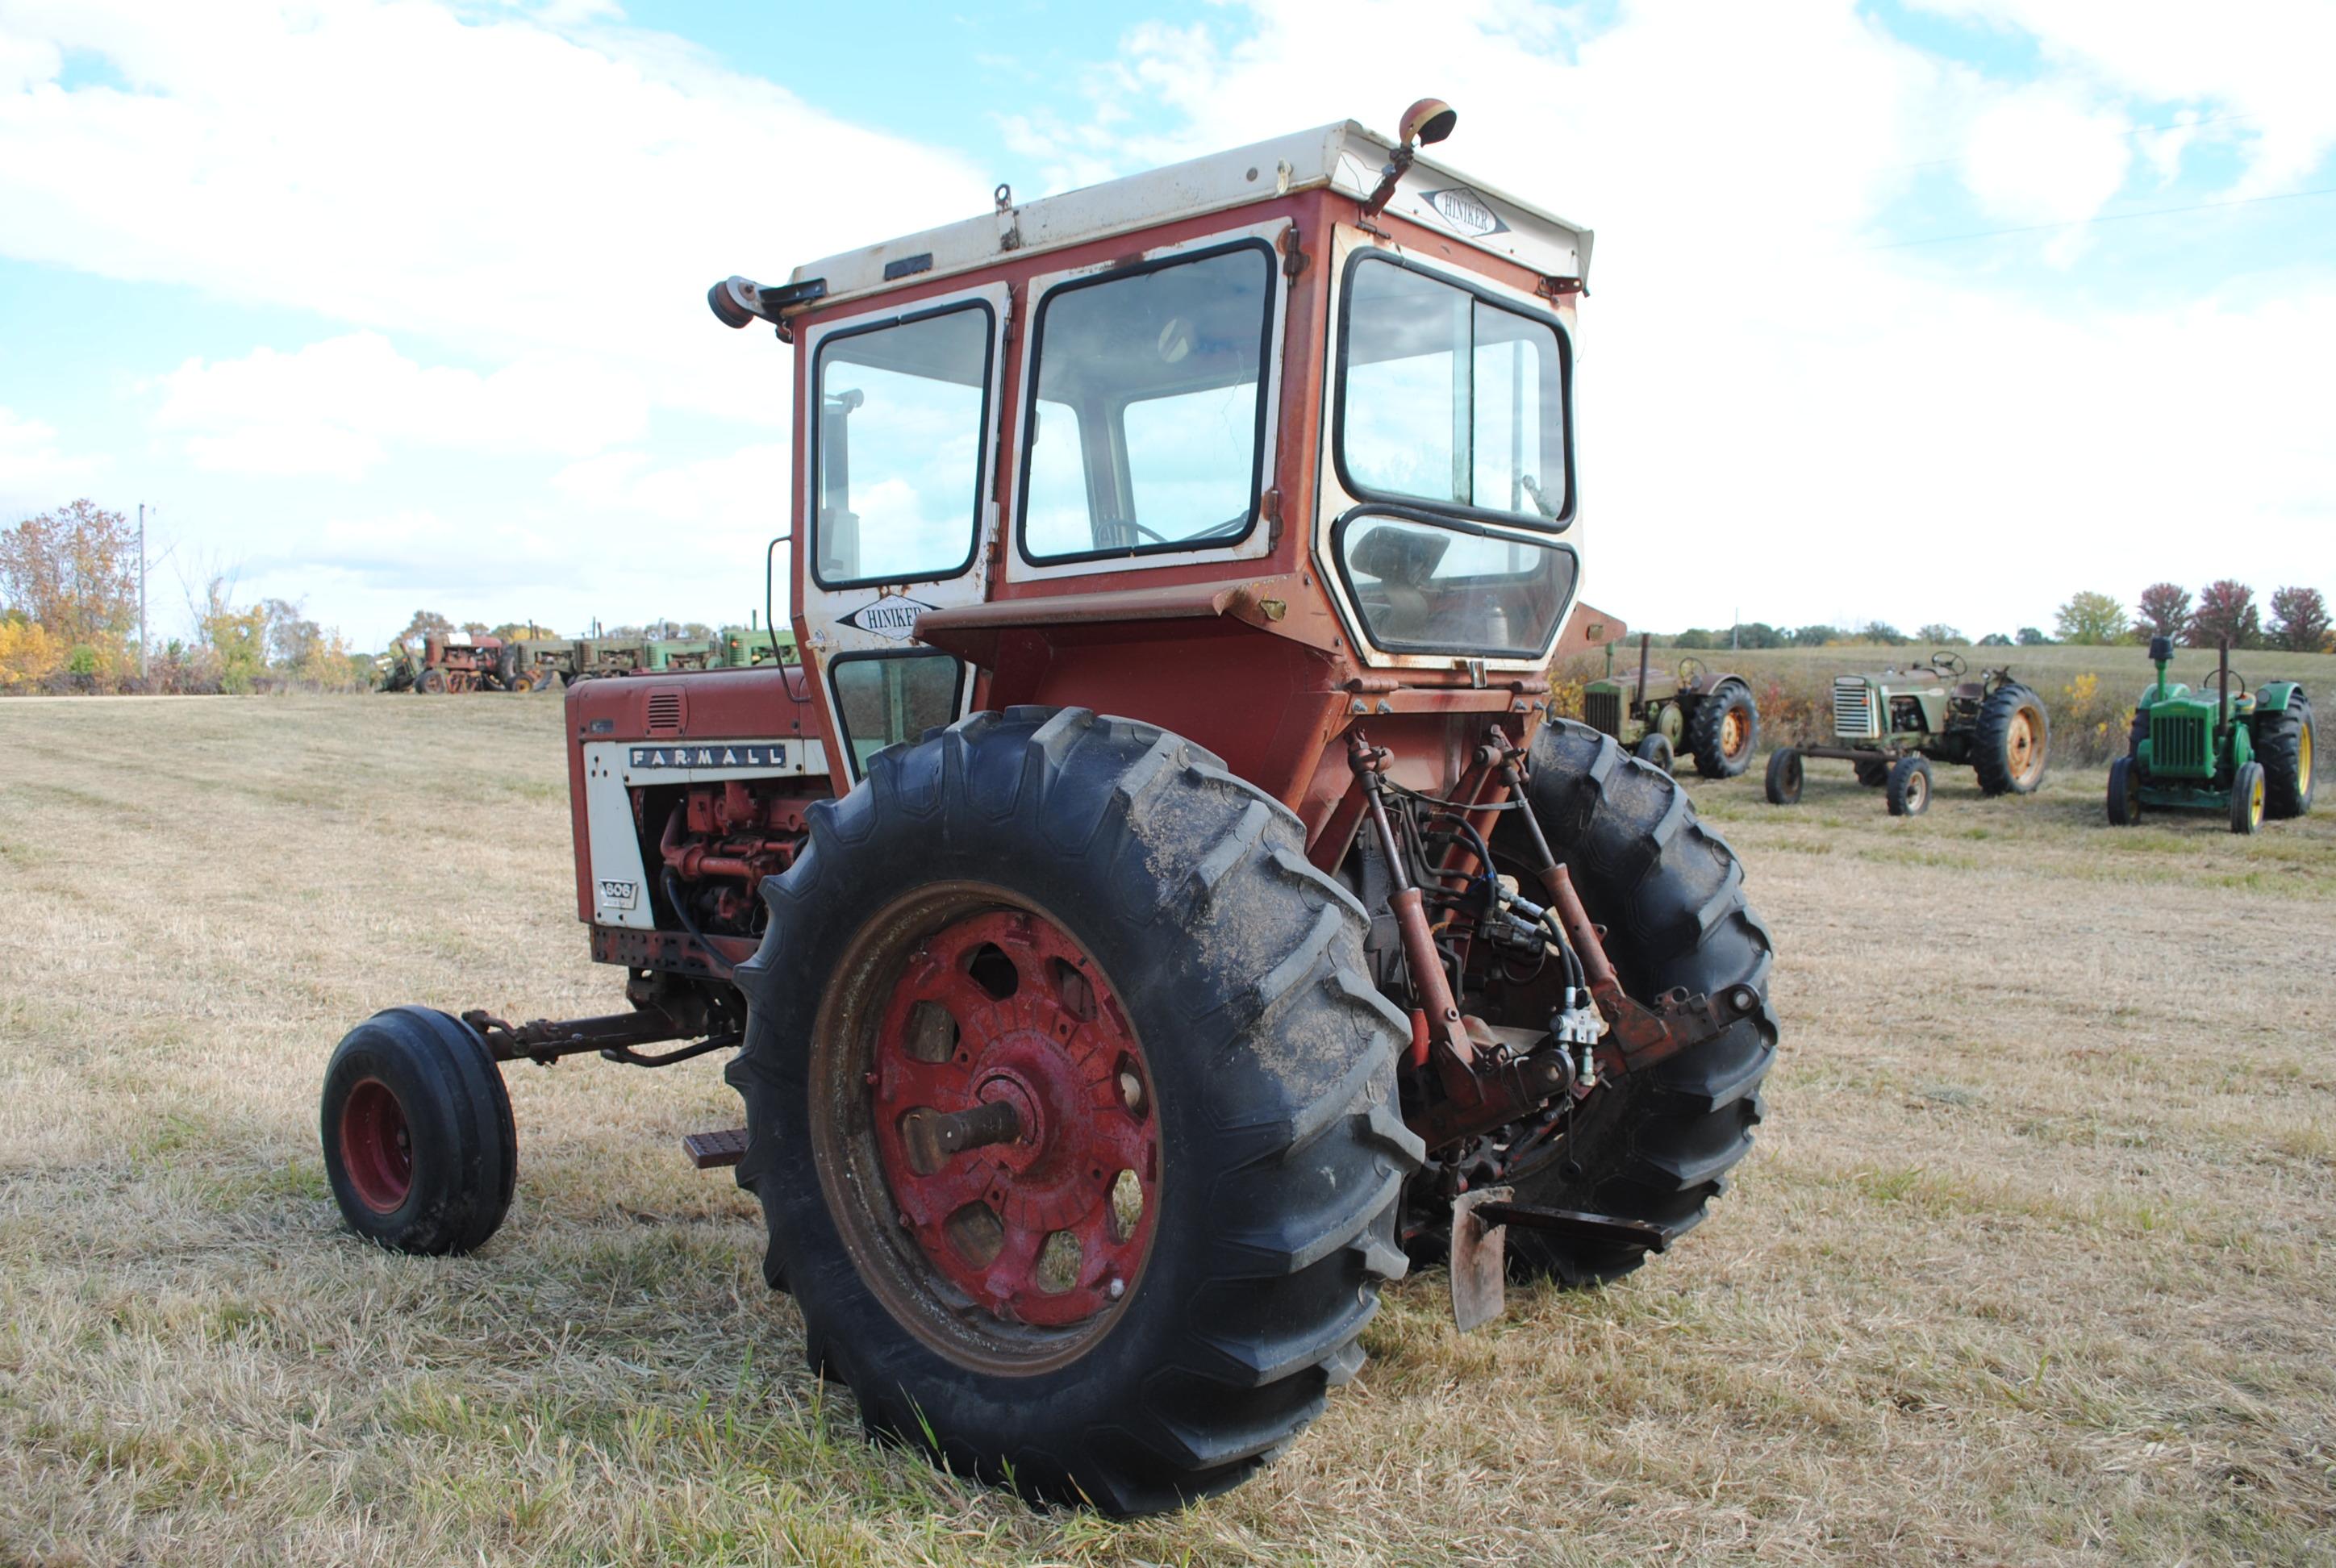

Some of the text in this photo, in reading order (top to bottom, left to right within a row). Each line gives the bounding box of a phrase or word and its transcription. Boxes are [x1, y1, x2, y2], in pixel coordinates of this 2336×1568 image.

[1445, 193, 1488, 231] HINIKER
[632, 749, 782, 765] FARMALL
[606, 883, 631, 897] 806
